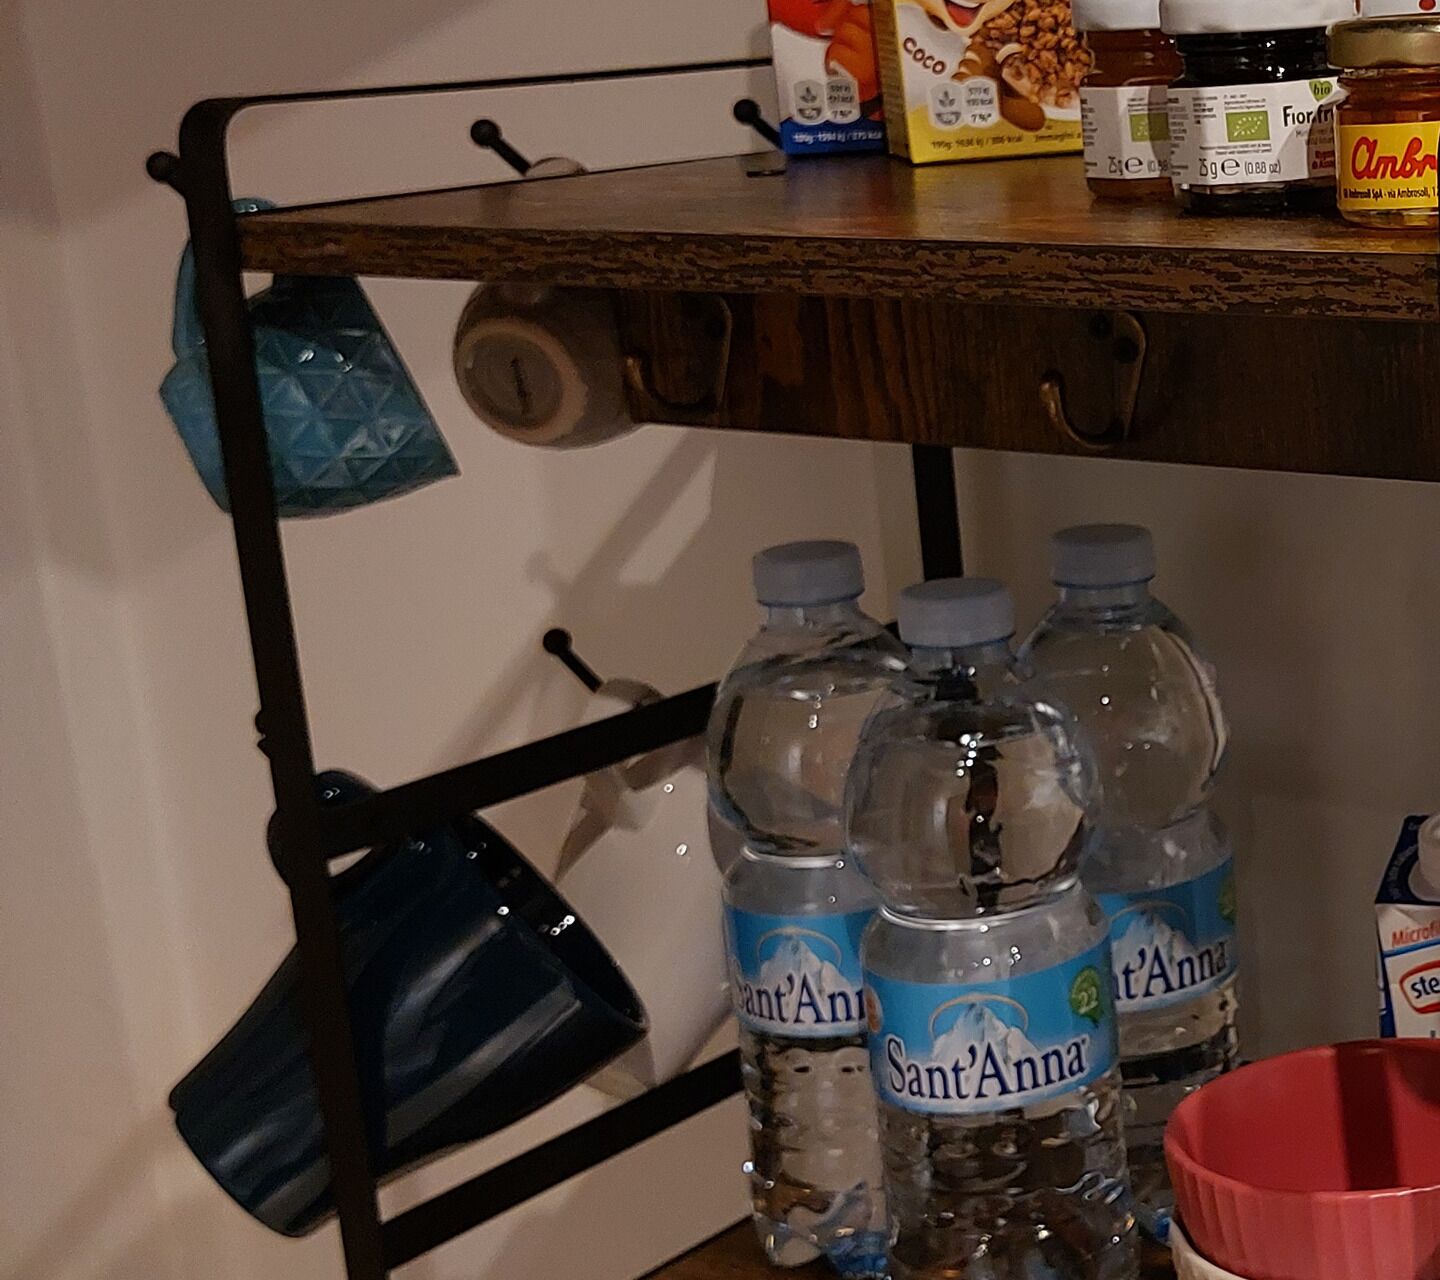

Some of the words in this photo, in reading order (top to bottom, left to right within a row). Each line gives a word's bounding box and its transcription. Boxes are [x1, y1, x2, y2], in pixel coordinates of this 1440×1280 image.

[1313, 83, 1330, 96] bio
[1283, 104, 1313, 127] Fior
[887, 1038, 1088, 1100] Sant'Anna
